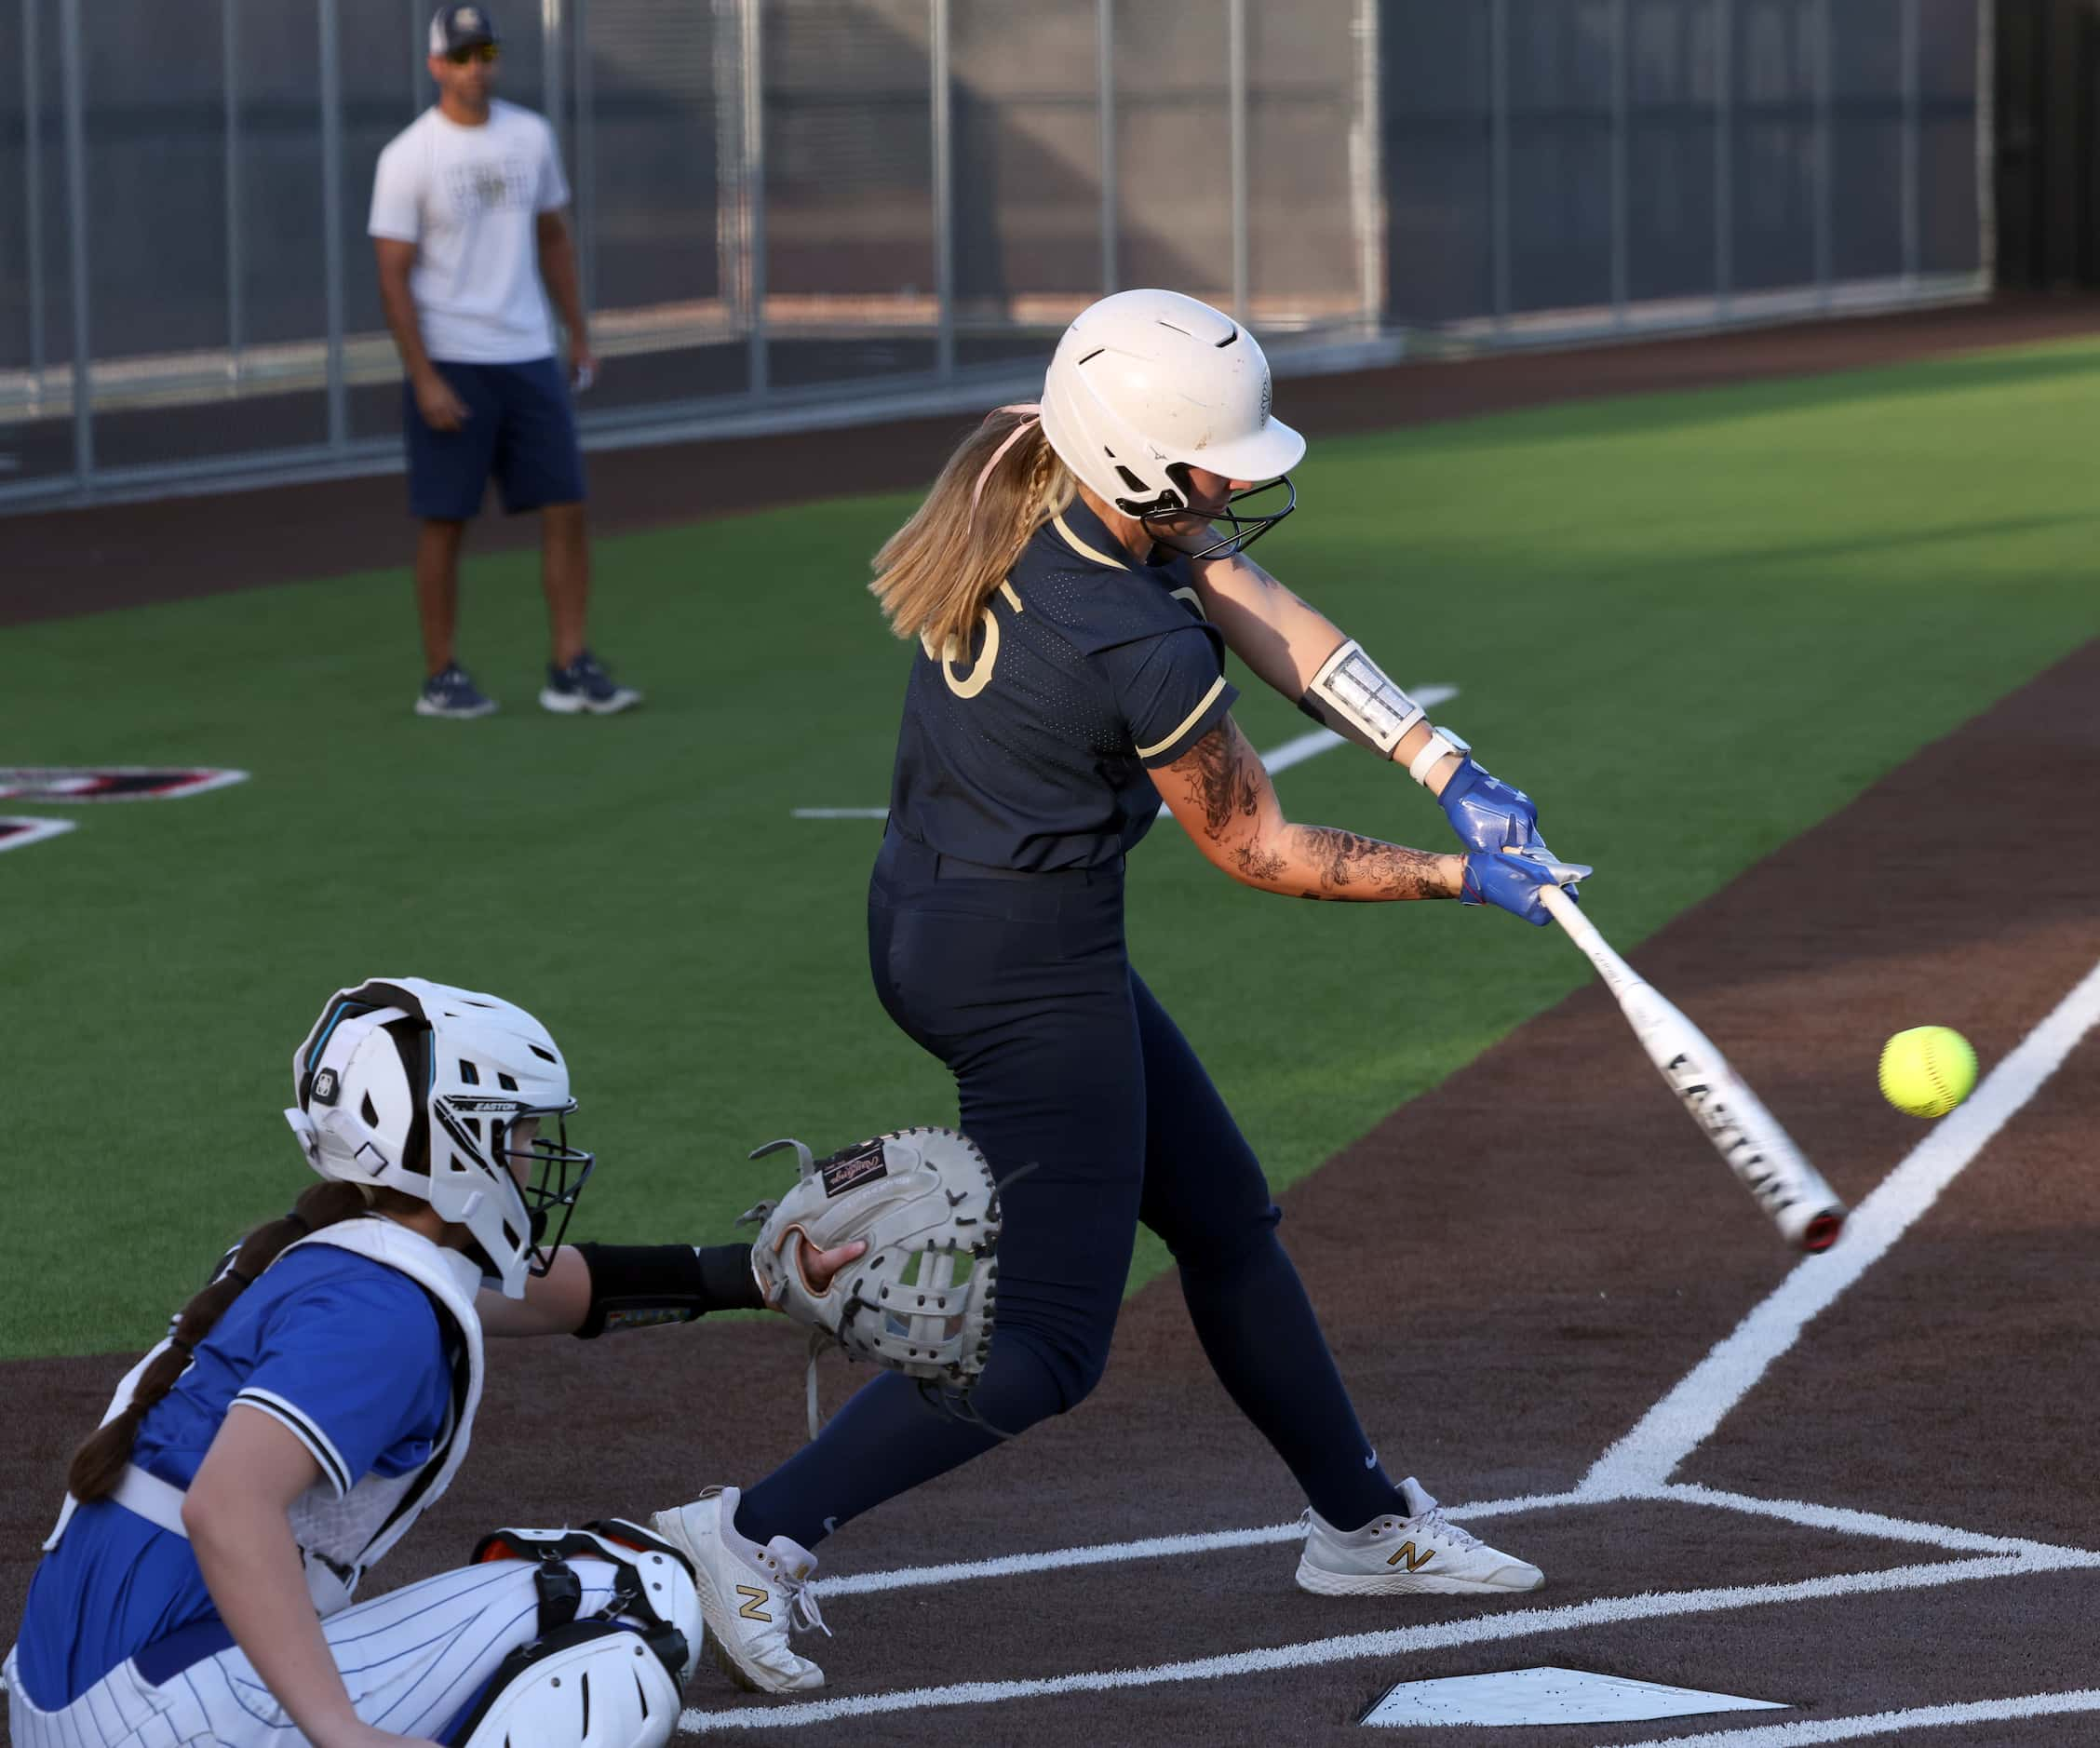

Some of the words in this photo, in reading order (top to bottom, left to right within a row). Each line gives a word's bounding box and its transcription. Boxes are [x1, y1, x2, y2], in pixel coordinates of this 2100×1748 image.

[473, 1102, 518, 1111] EASTON
[828, 1155, 881, 1185] Rawlings
[1386, 1540, 1436, 1573] N
[735, 1584, 773, 1623] N
